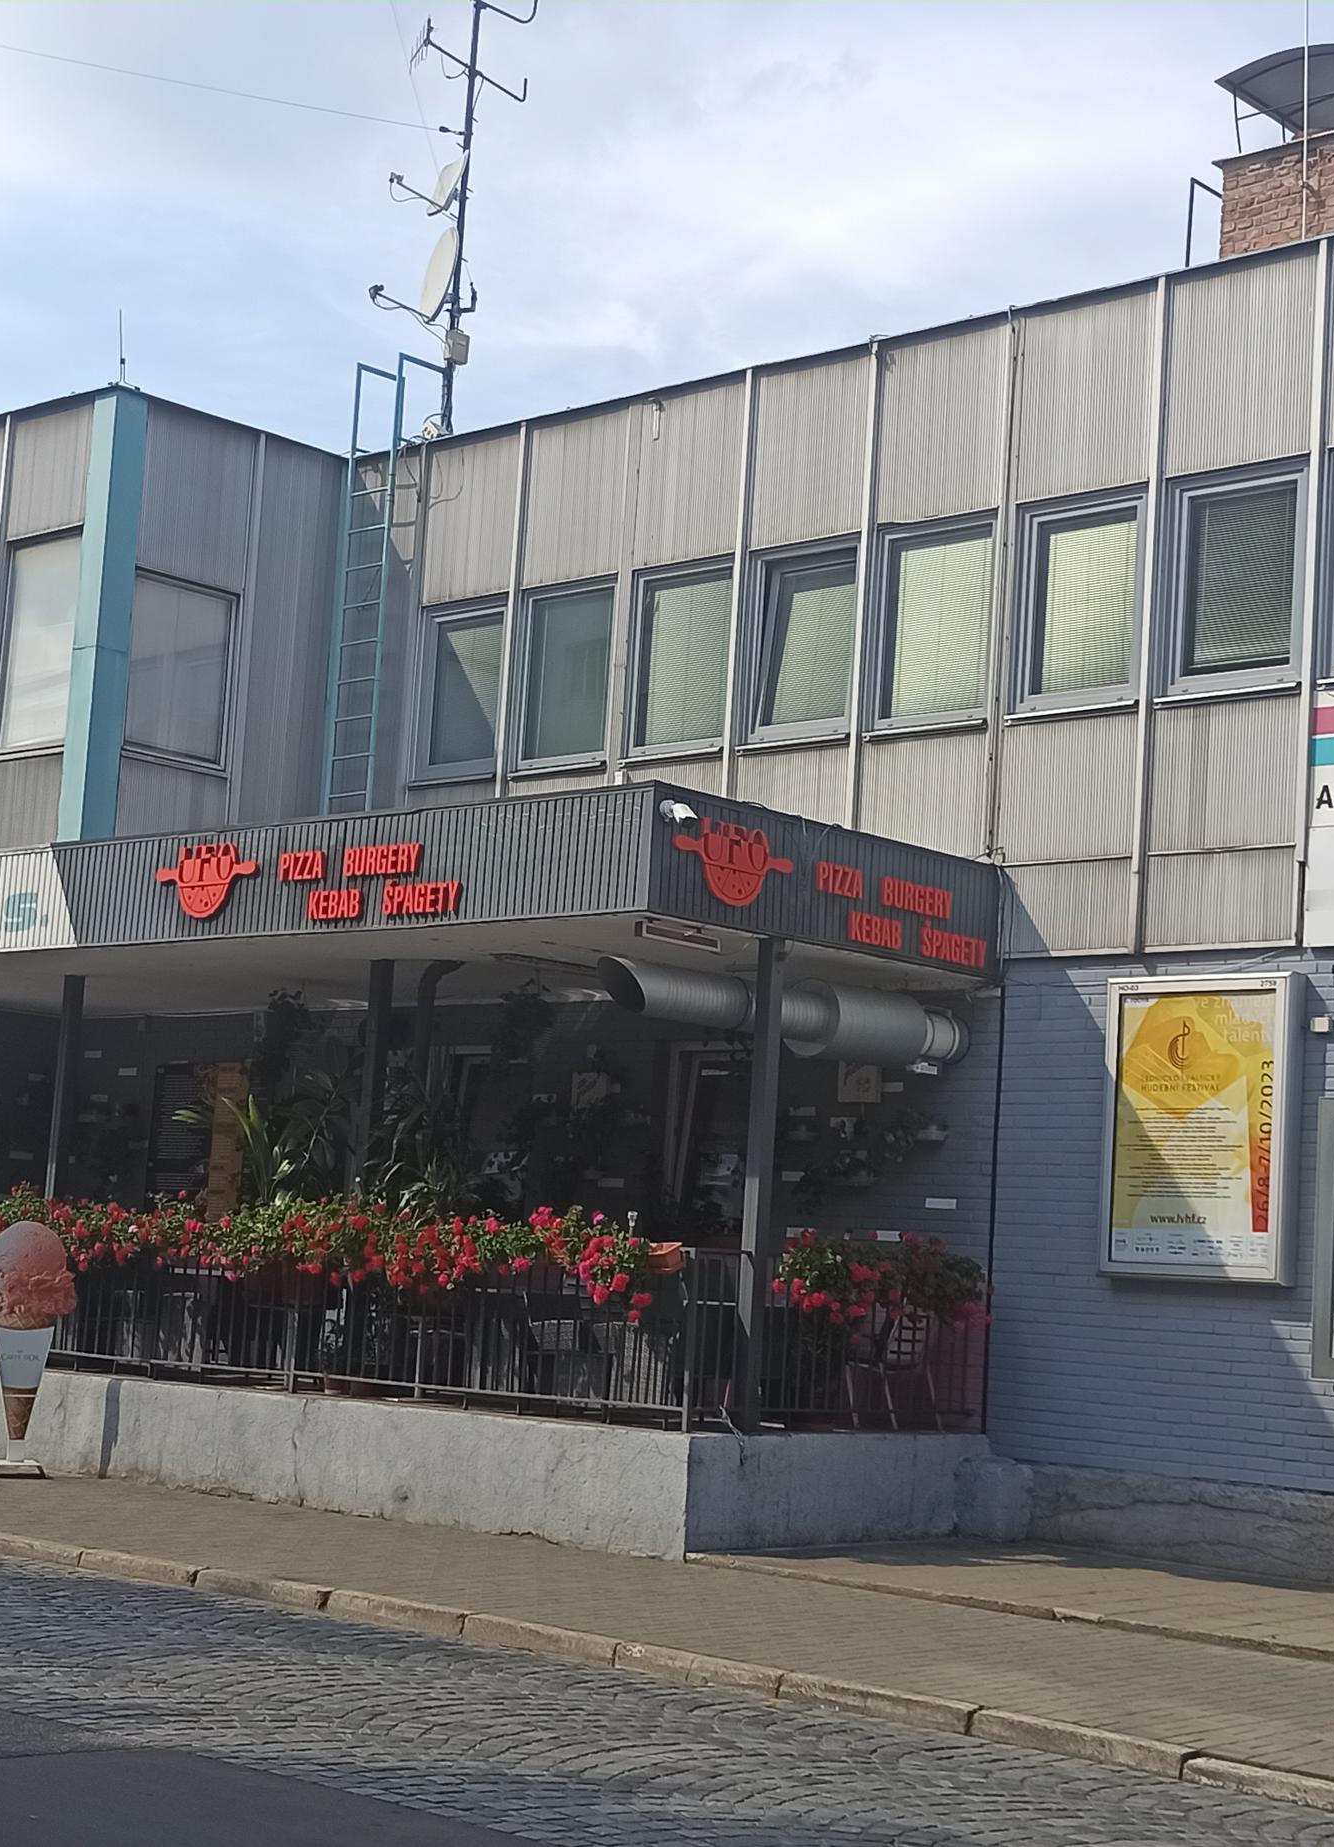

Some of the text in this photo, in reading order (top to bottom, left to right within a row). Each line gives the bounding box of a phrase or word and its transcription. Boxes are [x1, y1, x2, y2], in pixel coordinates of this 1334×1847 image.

[179, 842, 236, 883] UFO
[279, 842, 422, 881] PIZZA BURGERY
[306, 879, 460, 920] KEBAB ŠPAGETY
[815, 861, 953, 919] PIZZA BURGERY
[848, 911, 988, 969] KEBAB ŠPAGETY
